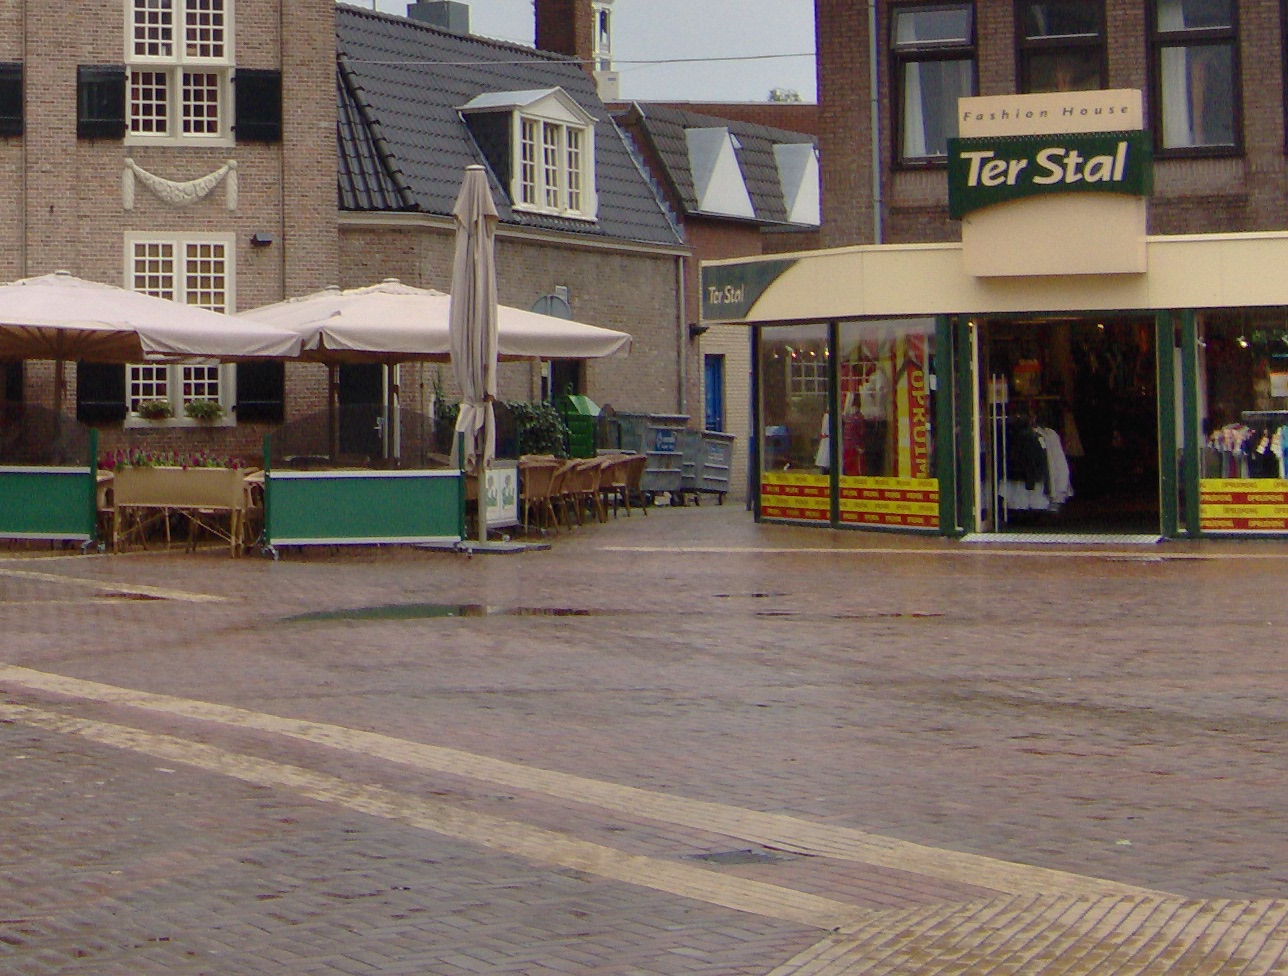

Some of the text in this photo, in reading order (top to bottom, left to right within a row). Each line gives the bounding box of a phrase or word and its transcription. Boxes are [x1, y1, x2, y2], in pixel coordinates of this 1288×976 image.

[963, 105, 1129, 122] Fashion House
[960, 140, 1129, 187] Ter Stal
